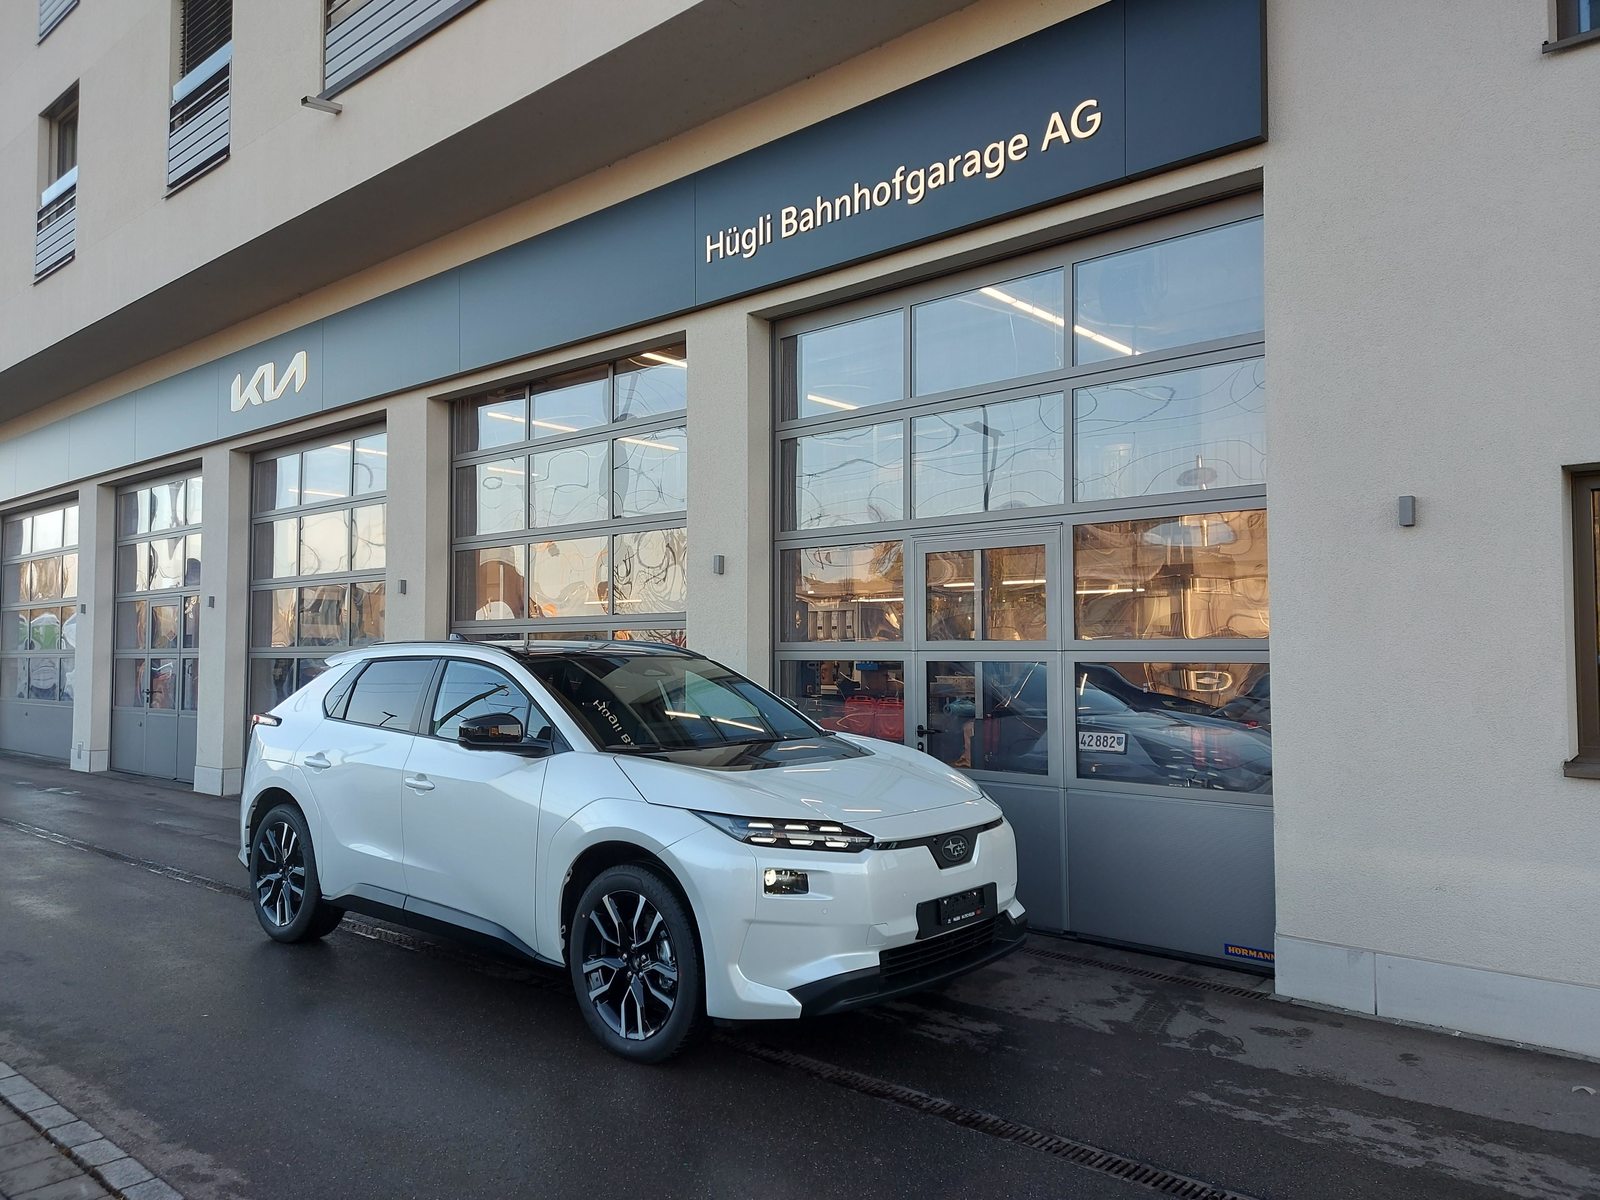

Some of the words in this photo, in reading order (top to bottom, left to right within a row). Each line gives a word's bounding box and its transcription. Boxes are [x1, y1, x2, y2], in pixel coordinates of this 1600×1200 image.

[706, 213, 772, 263] Hügli
[781, 132, 1029, 239] Bahnhofgarage
[1041, 99, 1102, 152] AG
[230, 350, 307, 412] KIA
[1080, 734, 1116, 749] 42882
